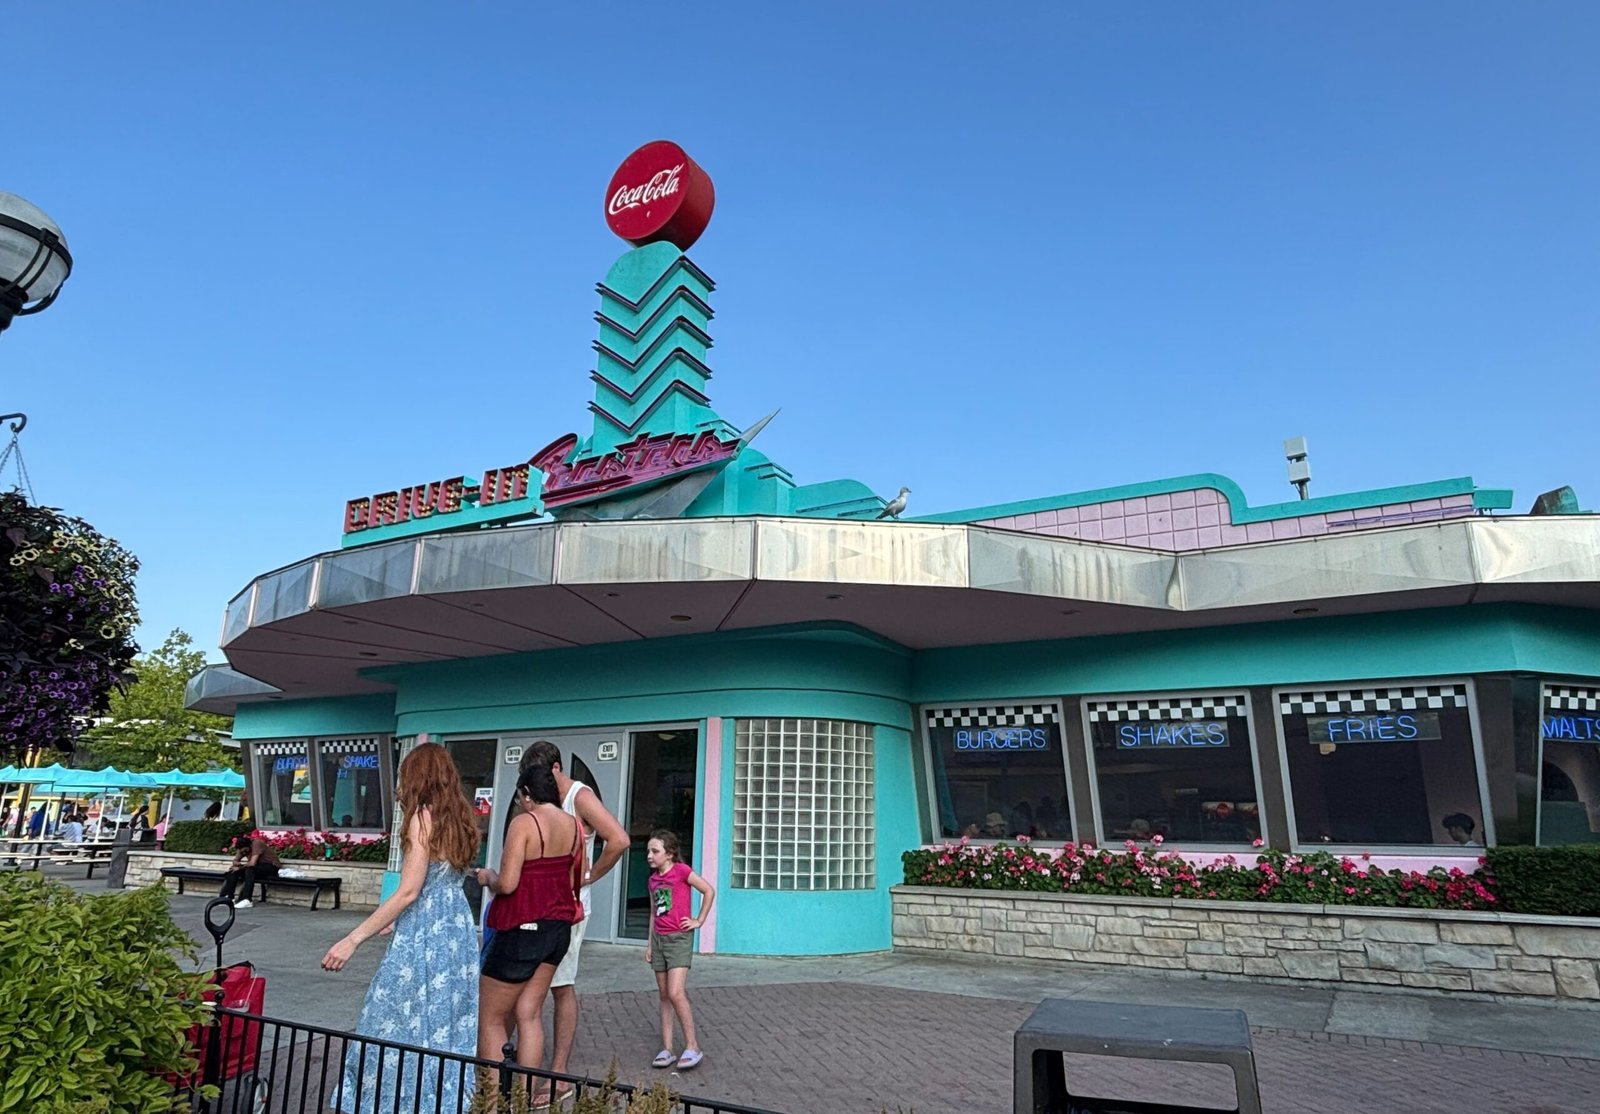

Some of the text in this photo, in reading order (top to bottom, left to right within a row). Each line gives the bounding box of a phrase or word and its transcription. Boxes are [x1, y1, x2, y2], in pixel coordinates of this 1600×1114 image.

[608, 163, 685, 215] Coca-Cola
[956, 728, 1046, 749] BURGERS
[1120, 723, 1225, 746] SHAKES
[1328, 715, 1418, 741] FRIES
[343, 754, 380, 768] SHAKE
